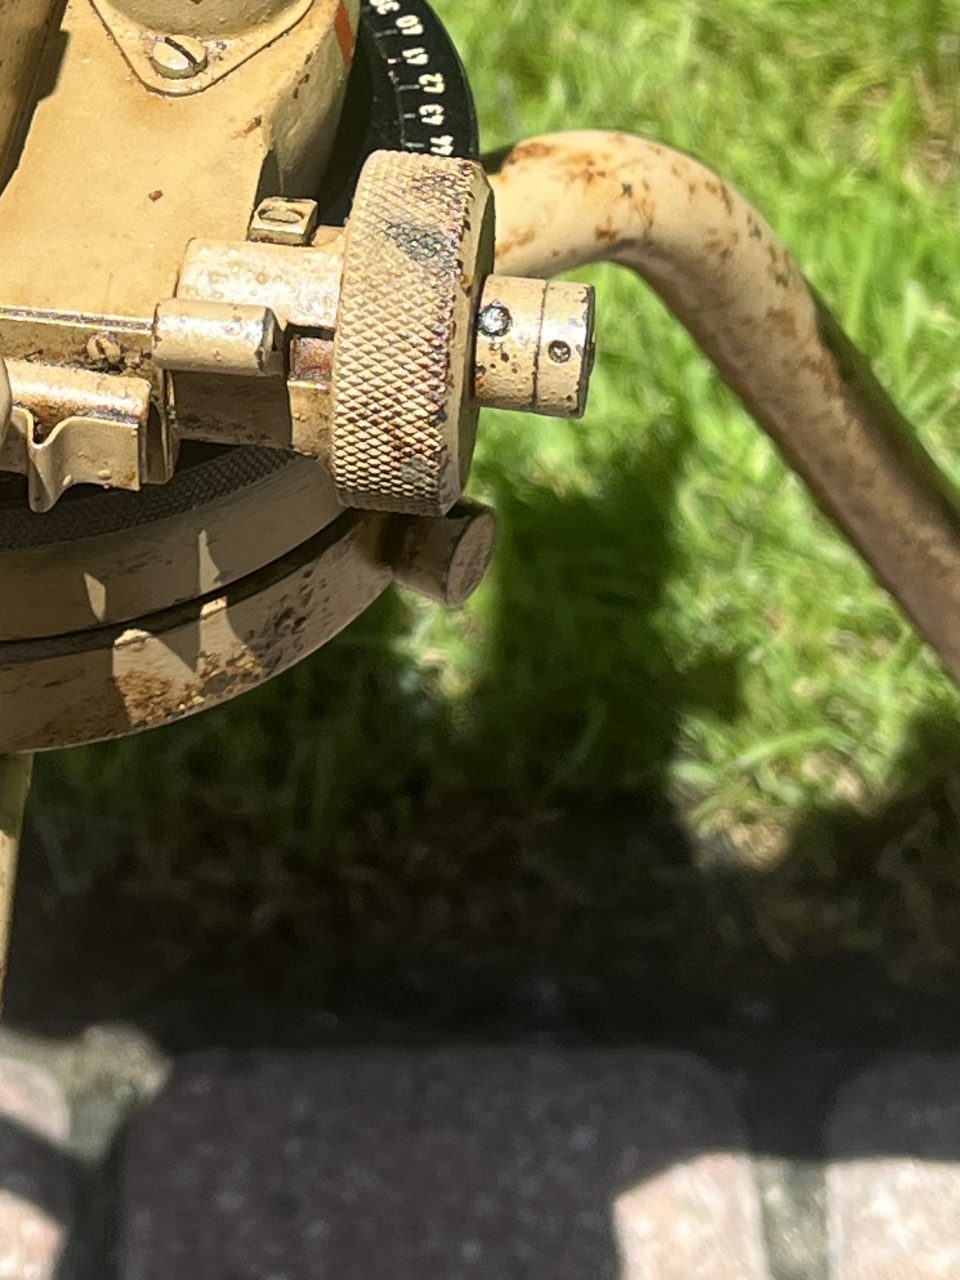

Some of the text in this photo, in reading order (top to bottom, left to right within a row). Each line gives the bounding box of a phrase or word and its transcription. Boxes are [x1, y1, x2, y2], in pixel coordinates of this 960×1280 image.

[395, 14, 423, 35] 40
[402, 47, 429, 65] 41
[418, 73, 446, 93] 42
[418, 104, 445, 125] 43
[430, 135, 454, 155] 44
